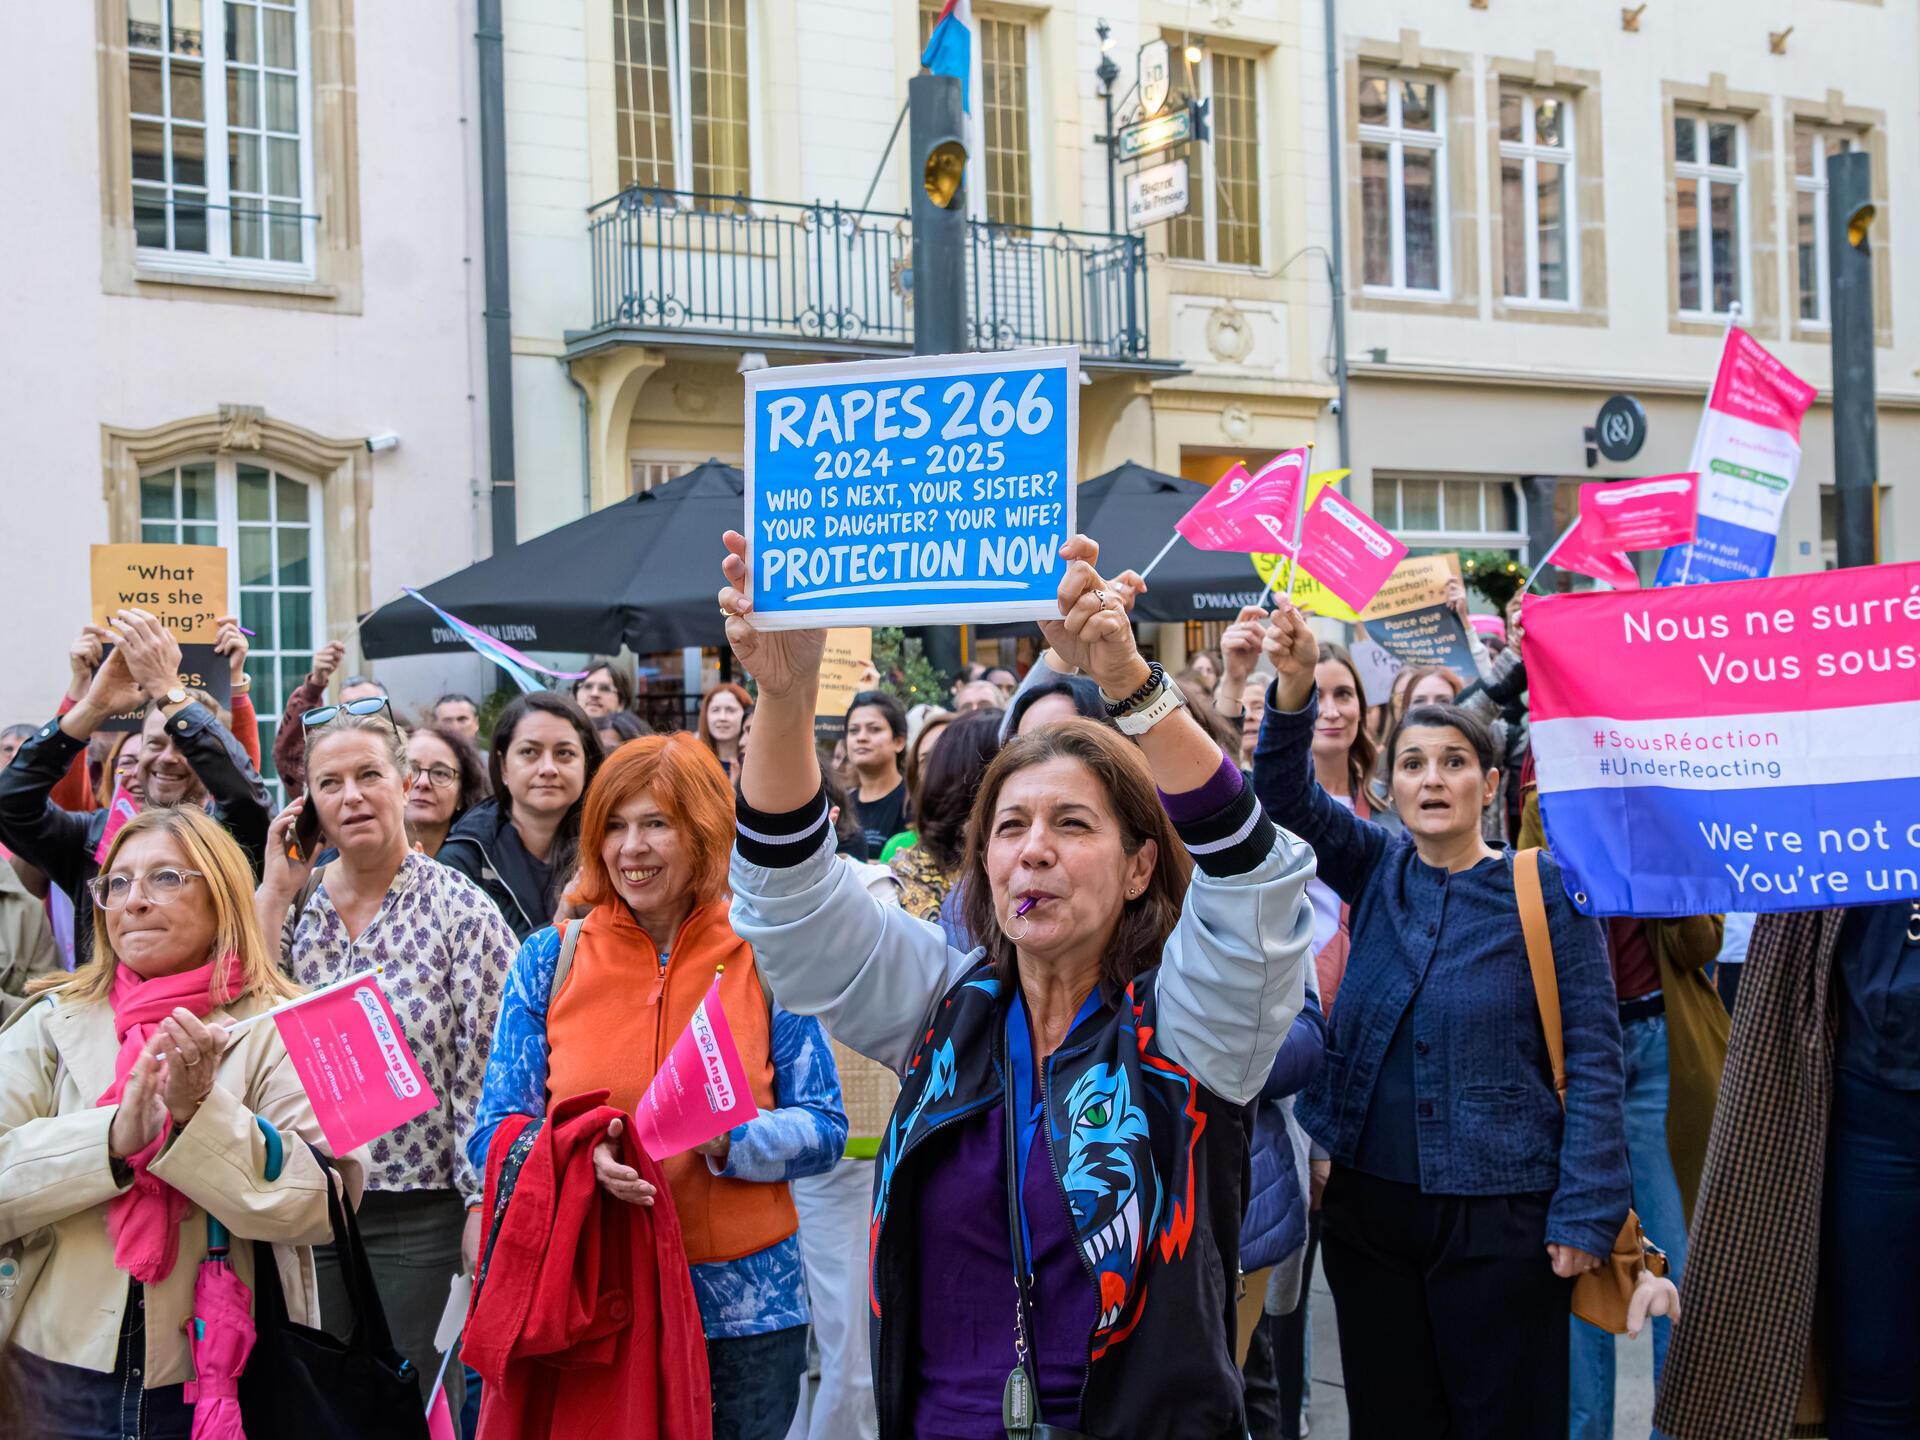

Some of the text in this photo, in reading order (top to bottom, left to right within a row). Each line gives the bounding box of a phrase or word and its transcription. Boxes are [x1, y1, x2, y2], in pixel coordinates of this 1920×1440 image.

[766, 373, 1054, 452] RAPES 266
[814, 441, 1006, 480] 2024 - 2025
[766, 471, 1058, 512] WHO IS NEXT, YOUR SISTER?
[762, 503, 1062, 542] YOUR DAUGHTER? YOUR WIFE?
[761, 533, 1059, 592] PROTECTION NOW
[119, 589, 203, 604] was she
[1623, 610, 1730, 644] Nous
[1746, 608, 1795, 636] ne
[1698, 652, 1799, 685] Vous
[1593, 729, 1779, 752] #SousRéaction
[1600, 758, 1781, 778] #UnderReacting
[1698, 821, 1802, 853] We're
[1819, 820, 1890, 853] not
[1725, 863, 1849, 895] You're
[358, 990, 379, 1015] ASK
[373, 1013, 391, 1042] FOR
[384, 1043, 416, 1095] Angela
[697, 1025, 714, 1054] FOR
[706, 1055, 730, 1107] Angela
